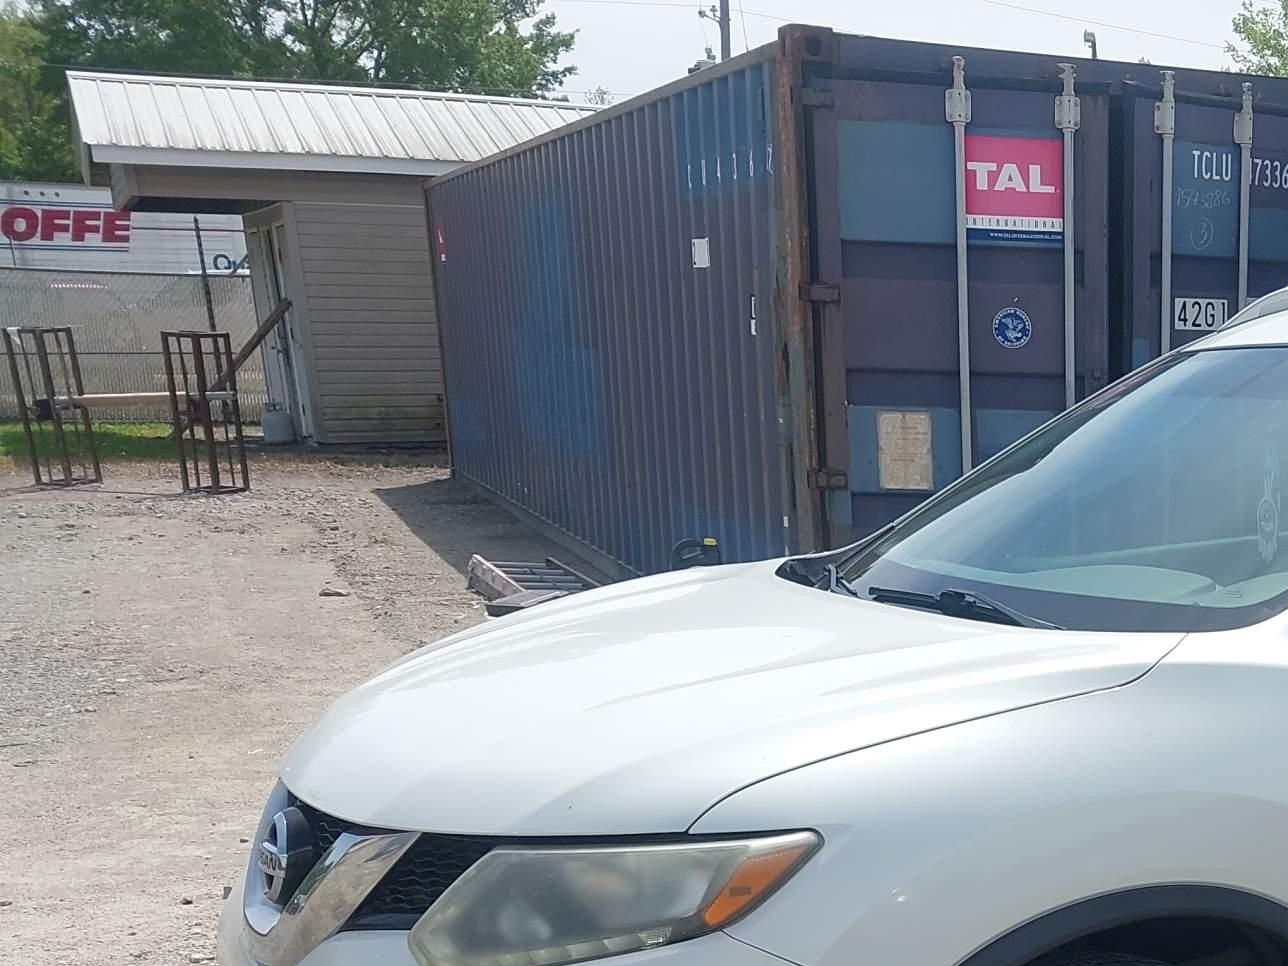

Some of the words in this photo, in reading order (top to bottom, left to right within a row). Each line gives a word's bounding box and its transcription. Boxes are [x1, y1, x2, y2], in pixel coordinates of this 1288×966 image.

[966, 161, 1055, 193] TAL
[1192, 151, 1232, 181] TCLU
[966, 217, 1063, 229] INTERNATIONAL
[1177, 300, 1226, 328] 42G1
